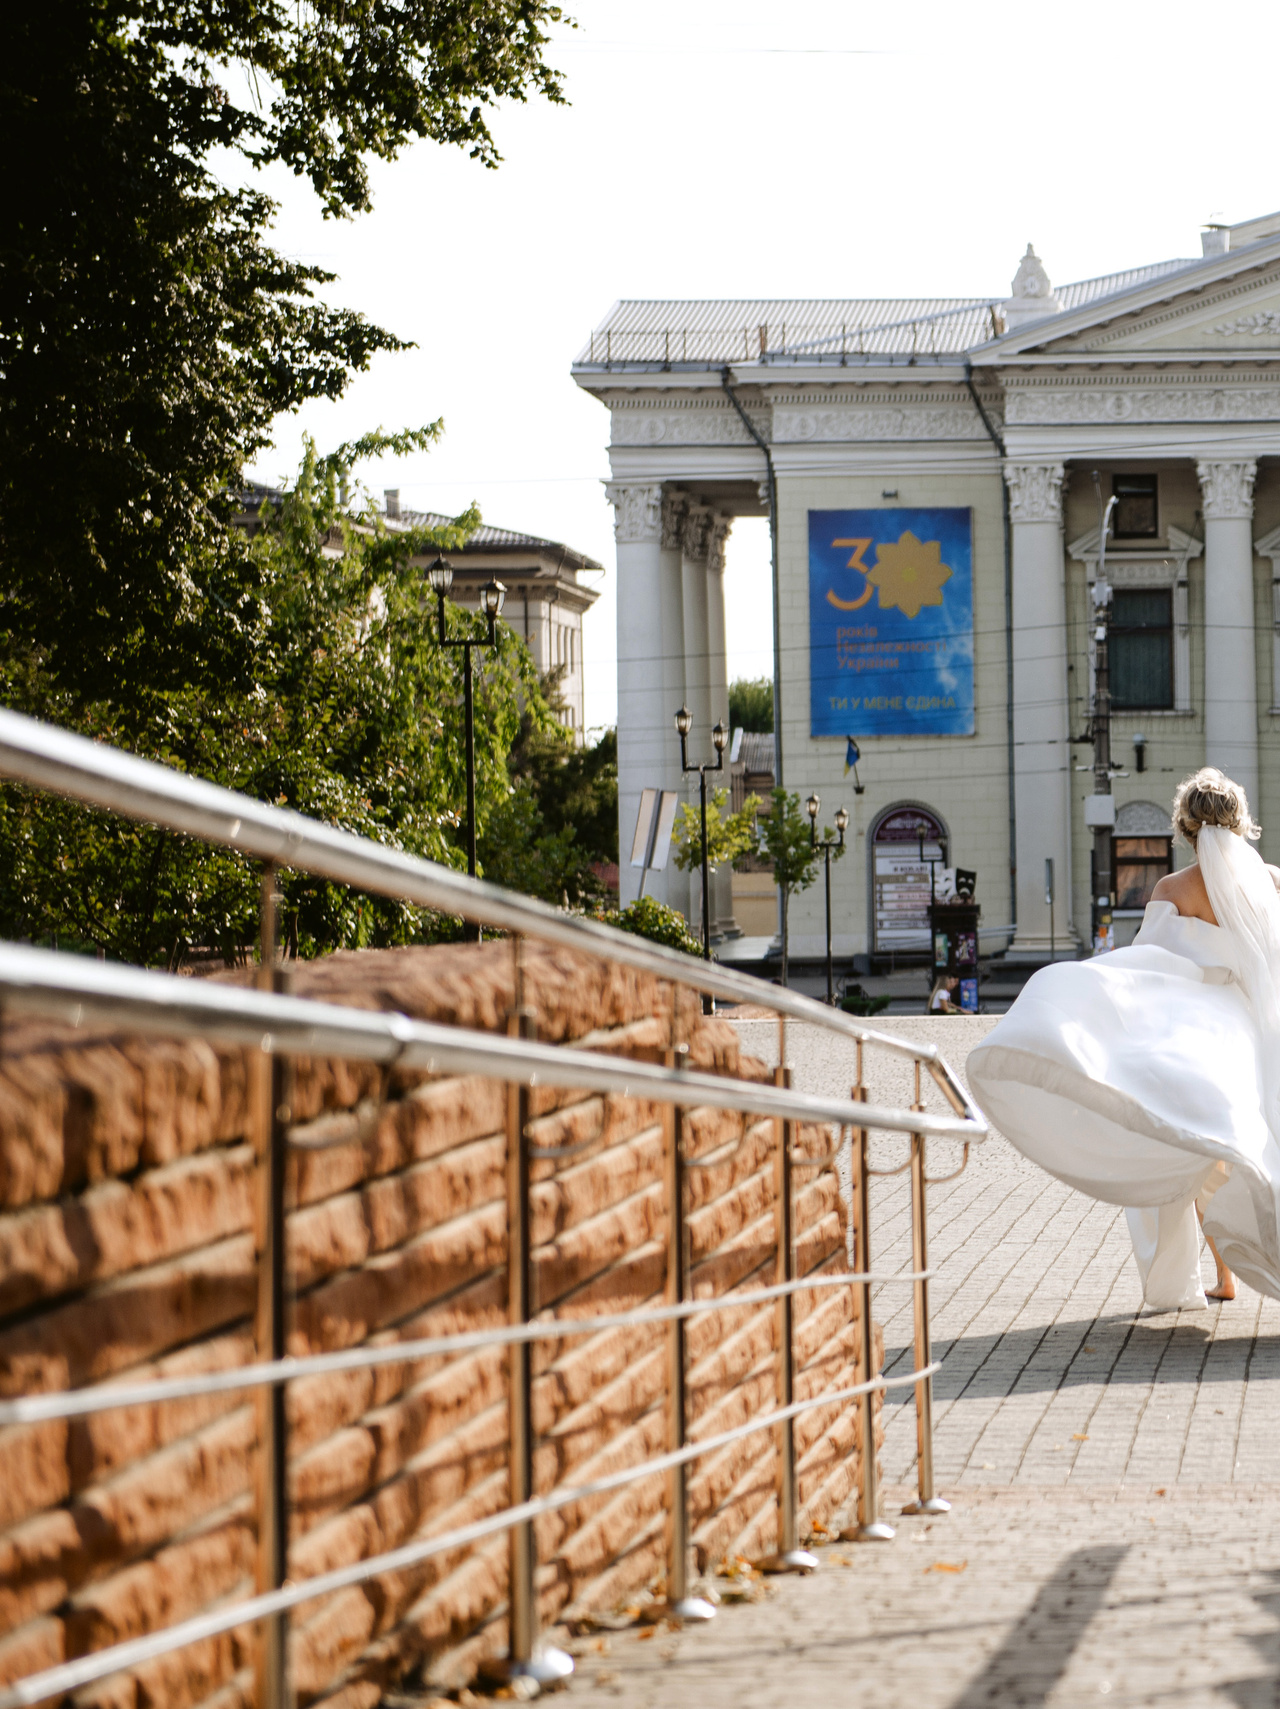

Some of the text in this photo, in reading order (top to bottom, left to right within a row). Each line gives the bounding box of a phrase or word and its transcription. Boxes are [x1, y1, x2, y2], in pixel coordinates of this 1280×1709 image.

[836, 623, 878, 639] років
[836, 640, 947, 653] Незалежності
[837, 655, 899, 672] України
[829, 695, 956, 711] ТИ У МЕНЕ ЄДИНА
